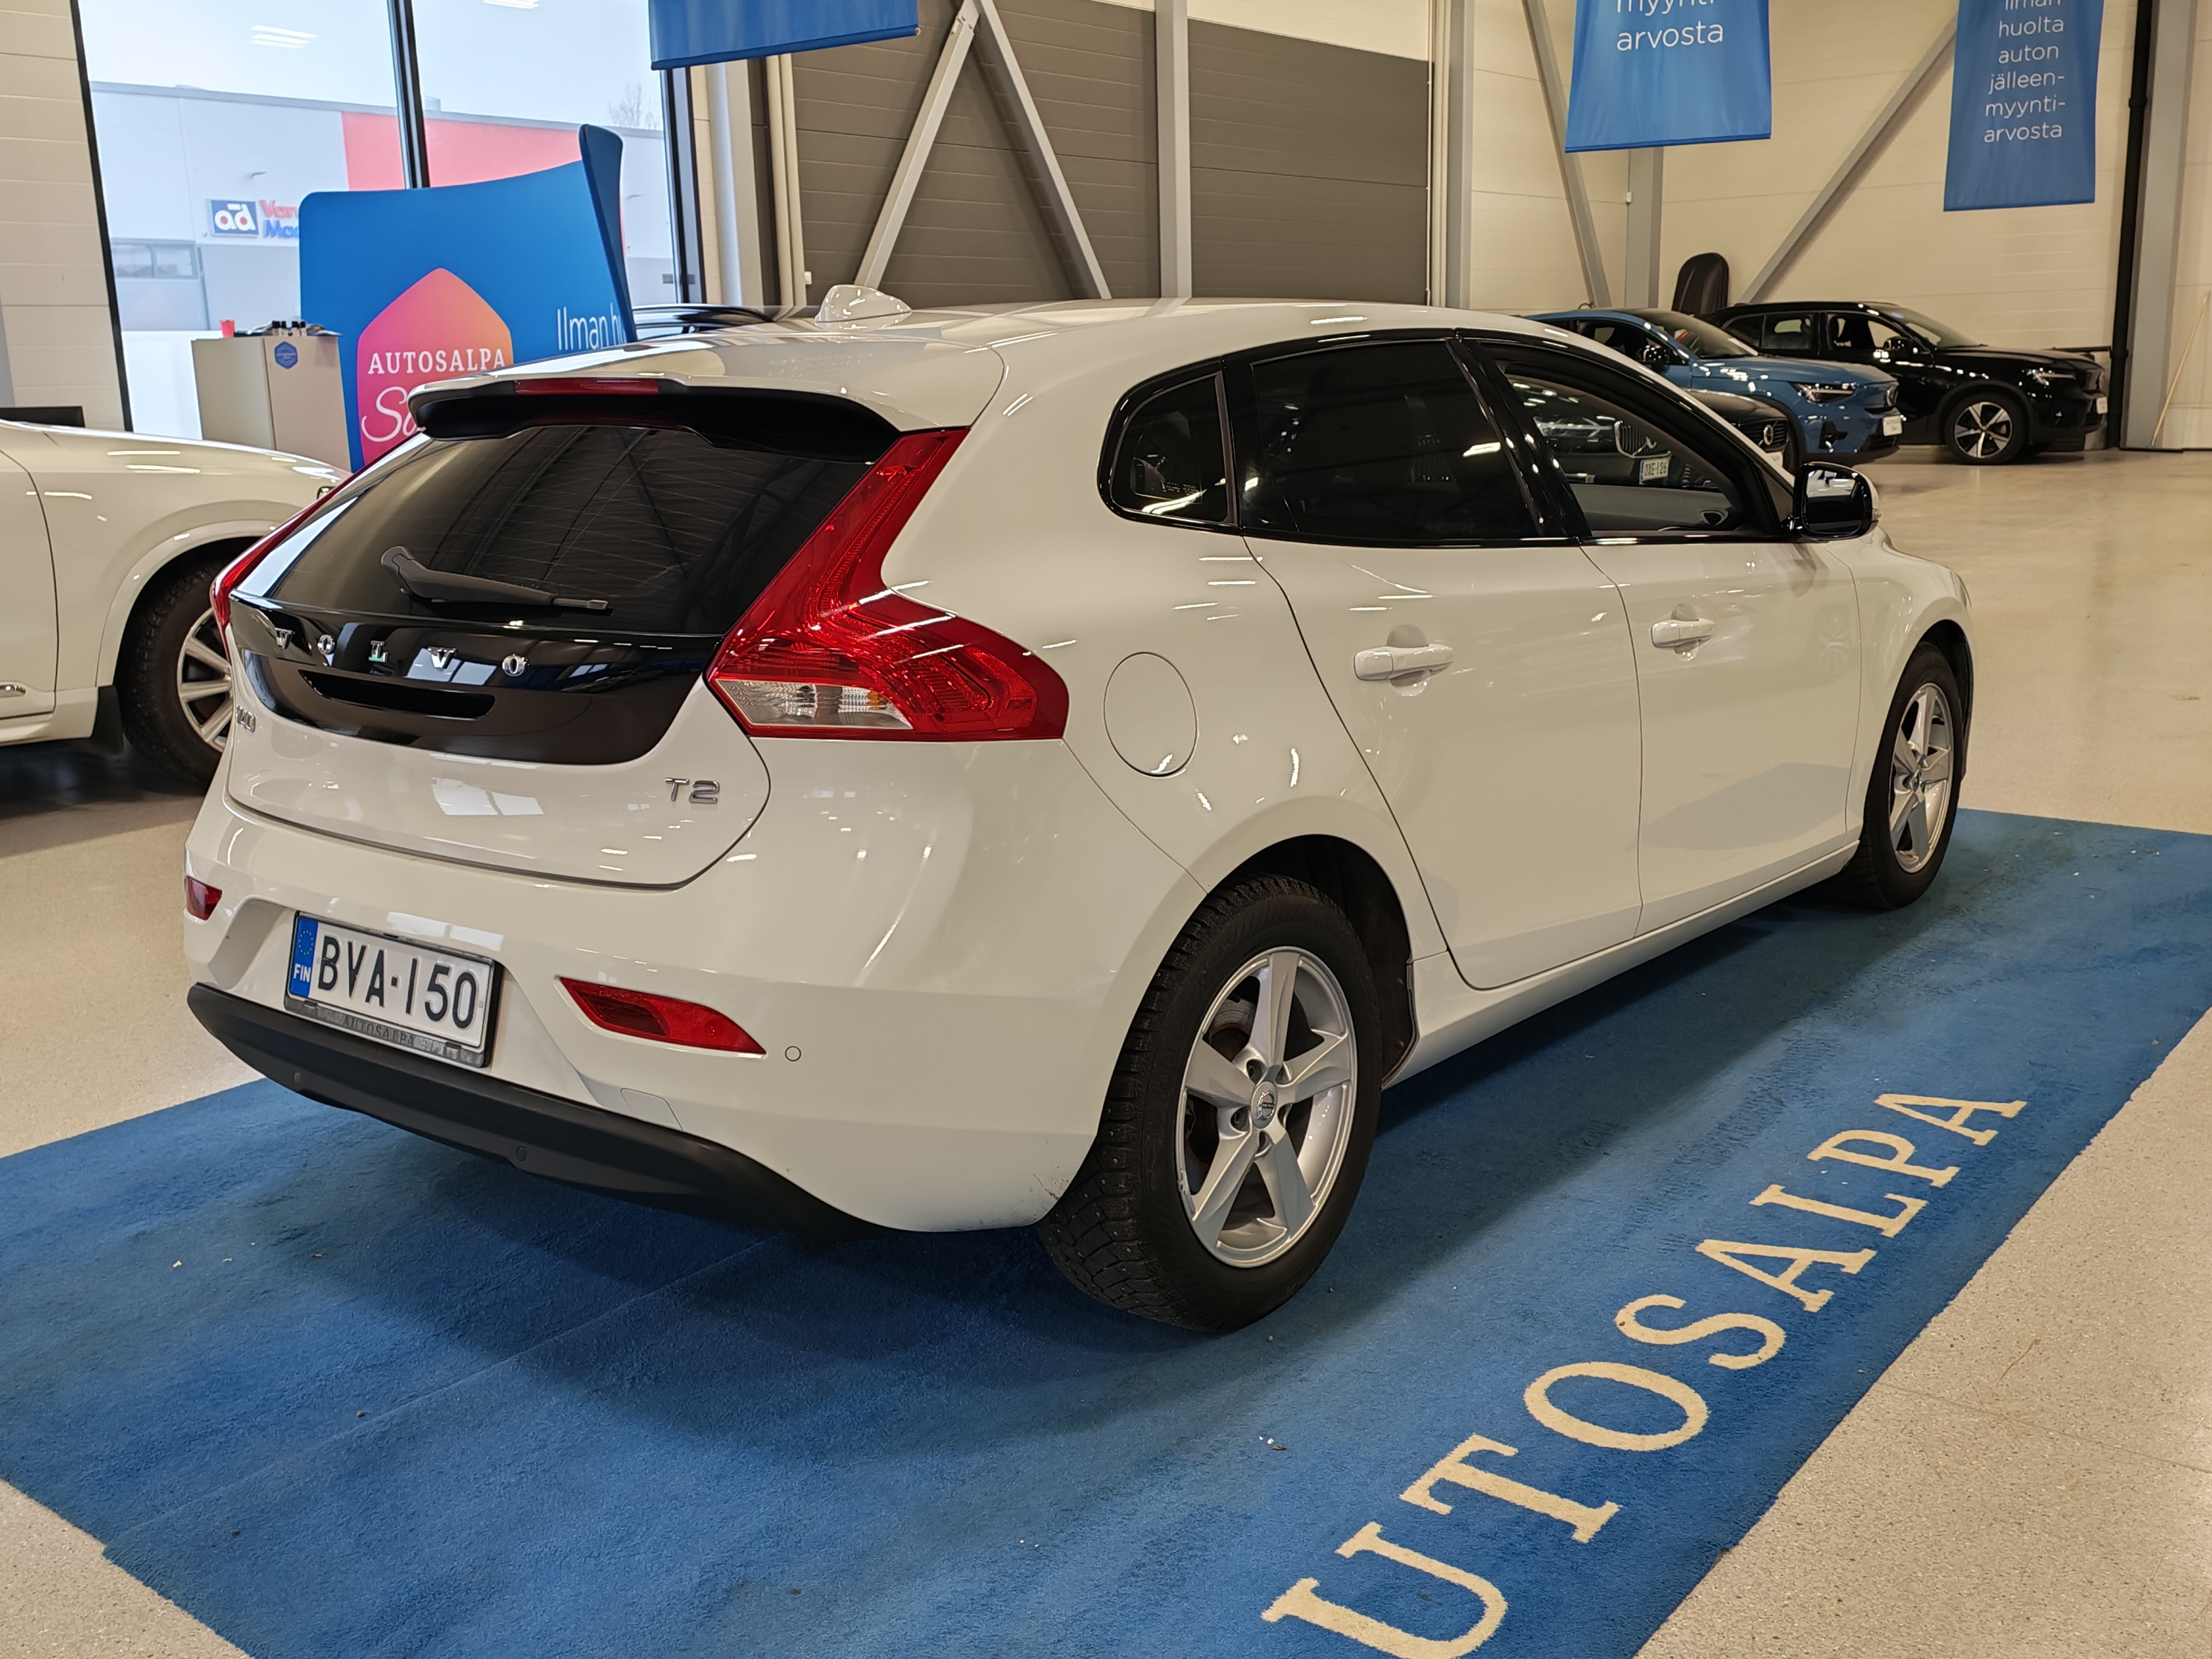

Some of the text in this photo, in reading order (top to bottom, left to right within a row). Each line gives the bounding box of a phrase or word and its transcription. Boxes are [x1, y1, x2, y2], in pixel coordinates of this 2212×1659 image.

[1616, 20, 1724, 51] arvosta
[1998, 15, 2065, 38] huolta
[1998, 44, 2059, 64] auton
[1988, 71, 2065, 95] jälleen-
[1985, 94, 2066, 119] myynti-
[1984, 122, 2062, 143] arvosta
[367, 348, 506, 375] AUTOSALPA
[274, 627, 530, 678] VOLVO
[664, 777, 720, 805] T2
[293, 963, 312, 983] FIN
[342, 1014, 415, 1047] AUTOSALPA
